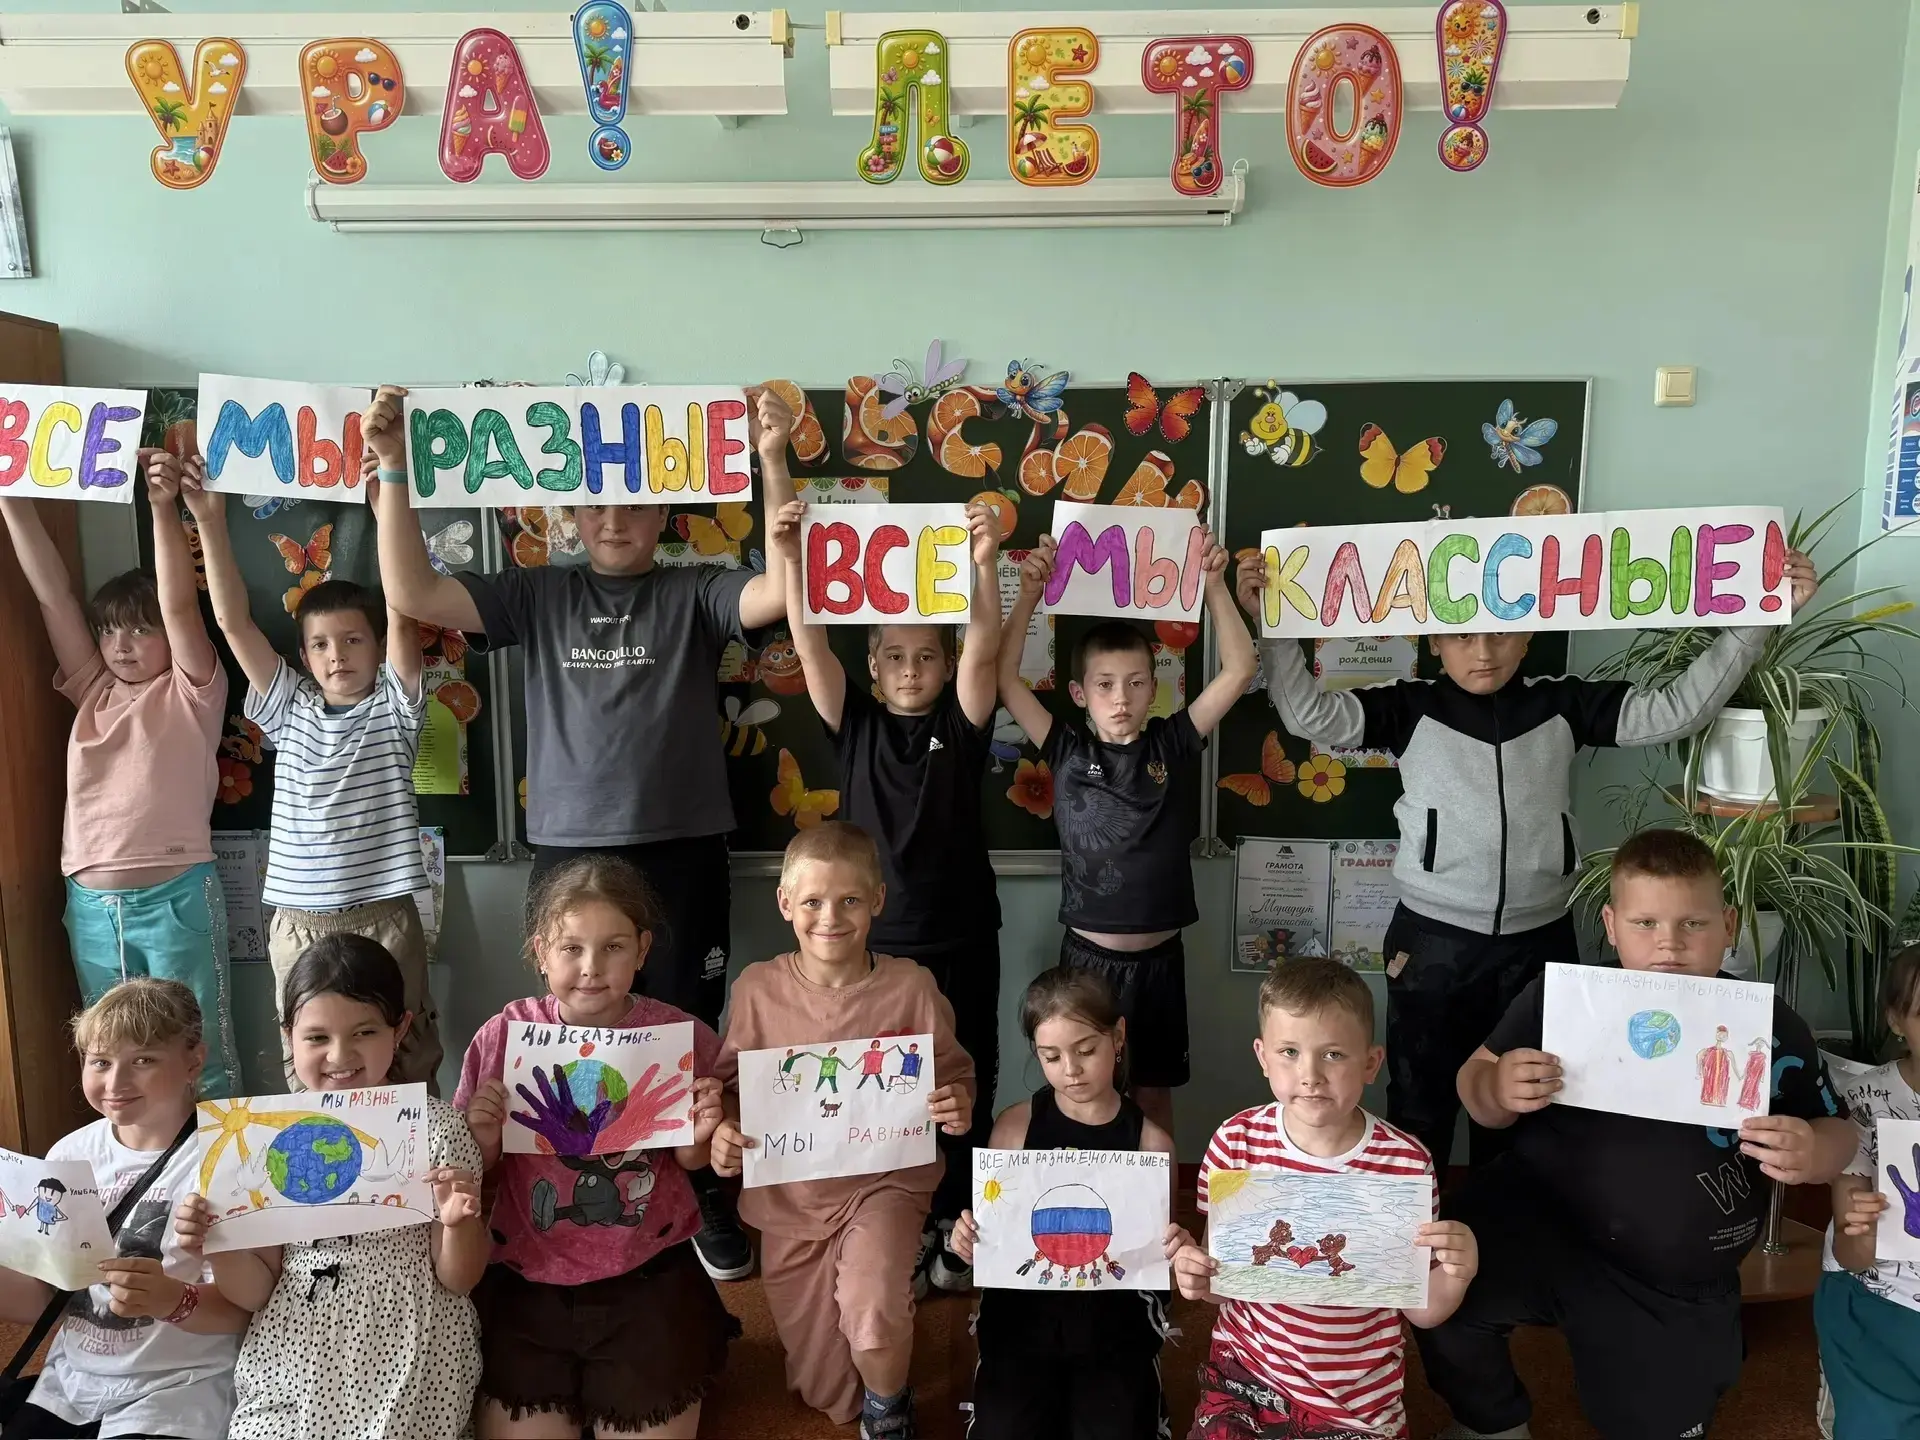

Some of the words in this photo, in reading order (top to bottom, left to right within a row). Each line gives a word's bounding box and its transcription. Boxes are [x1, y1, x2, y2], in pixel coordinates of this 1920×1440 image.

[125, 0, 634, 190] УРА!
[857, 0, 1508, 196] ЛЕТО!
[0, 397, 141, 489] ВСЕ
[207, 400, 362, 488] МЫ
[410, 401, 747, 497] РАЗНЫЕ
[807, 522, 968, 615] ВСЕ
[1044, 521, 1203, 612] МЫ
[1264, 521, 1785, 627] КЛАССНЫЕ!
[1339, 656, 1393, 666] рождения
[1355, 642, 1378, 652] Дни
[1265, 862, 1304, 870] ГРАМОТА
[1340, 858, 1394, 868] ГРАМОТ
[321, 1092, 344, 1109] МЫ
[349, 1091, 398, 1108] РАЗНЫЕ
[397, 1107, 421, 1122] МЫ
[765, 1132, 813, 1159] МЫ
[979, 1152, 1003, 1170] ВСЕ
[1008, 1153, 1030, 1168] МЫ
